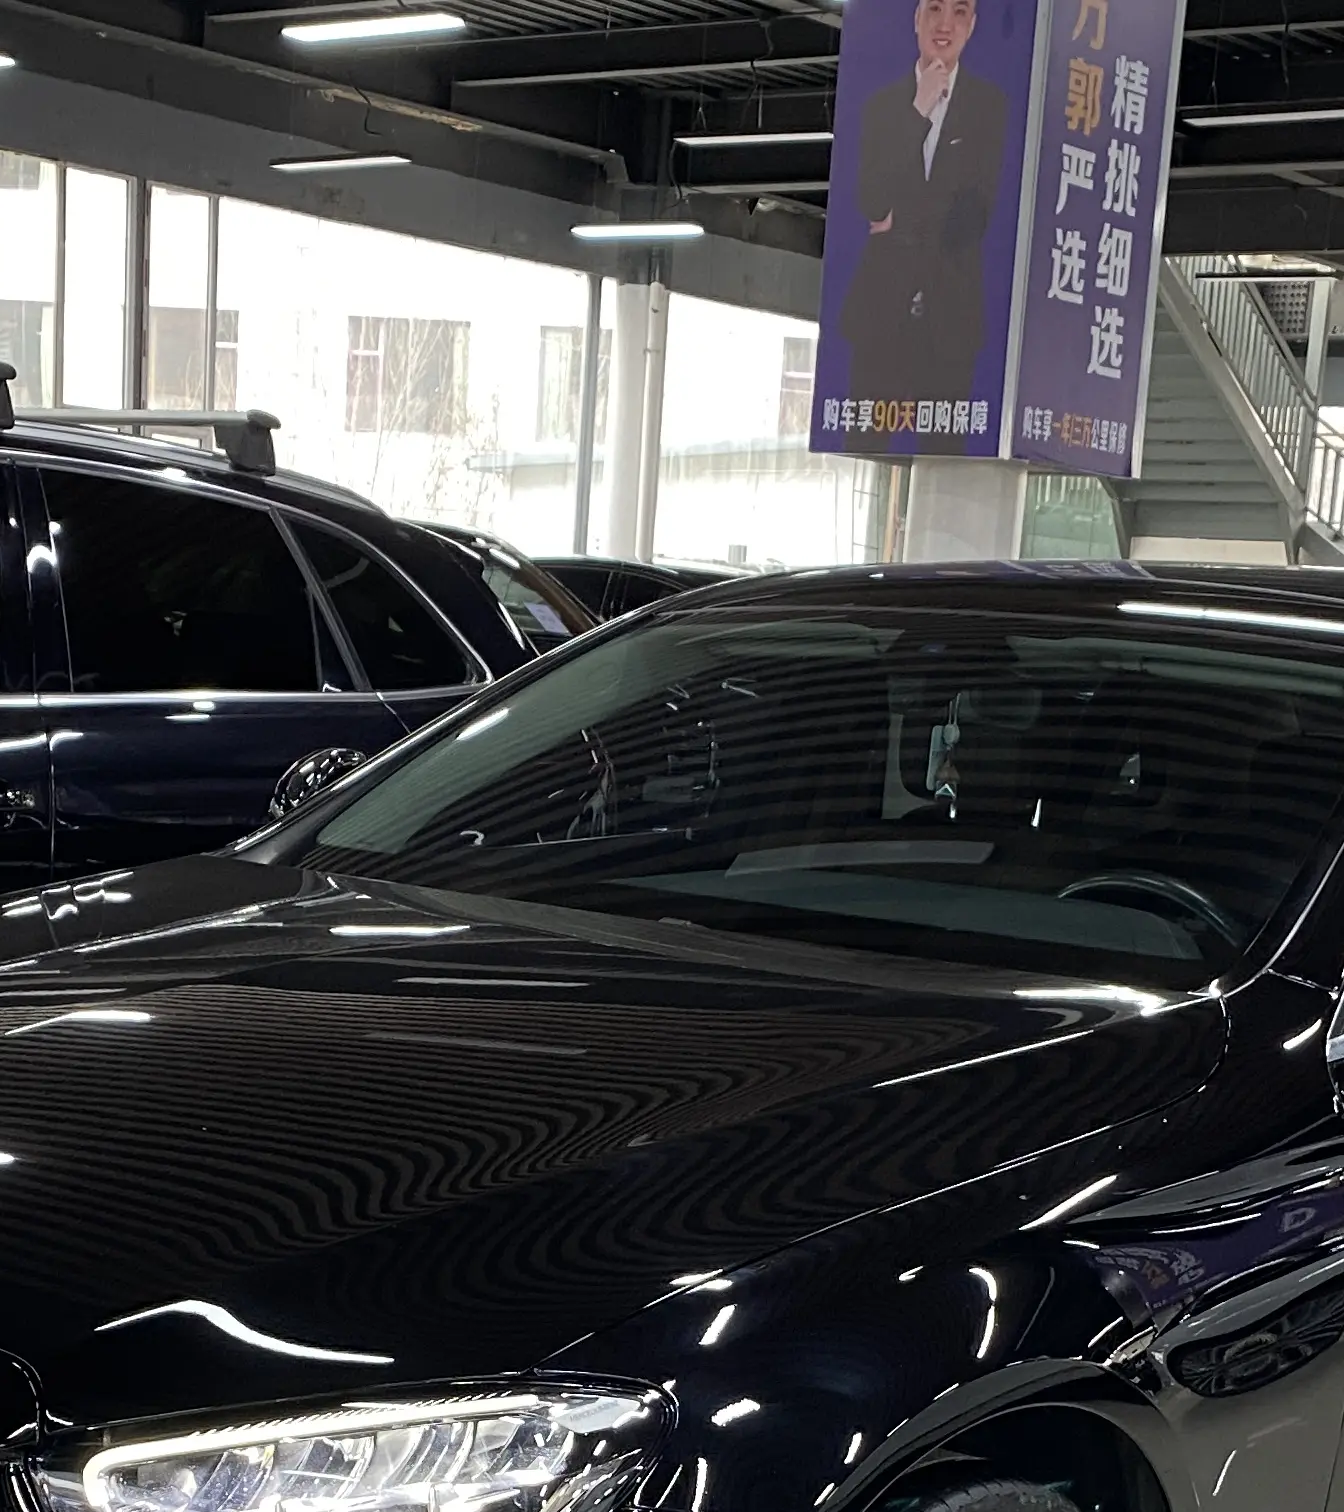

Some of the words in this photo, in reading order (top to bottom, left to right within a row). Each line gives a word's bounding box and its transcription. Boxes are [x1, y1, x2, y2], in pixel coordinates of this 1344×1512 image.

[1047, 0, 1108, 304] 万郭严选
[1085, 54, 1150, 380] 精挑细选
[822, 398, 989, 435] 购车享90天回购保障
